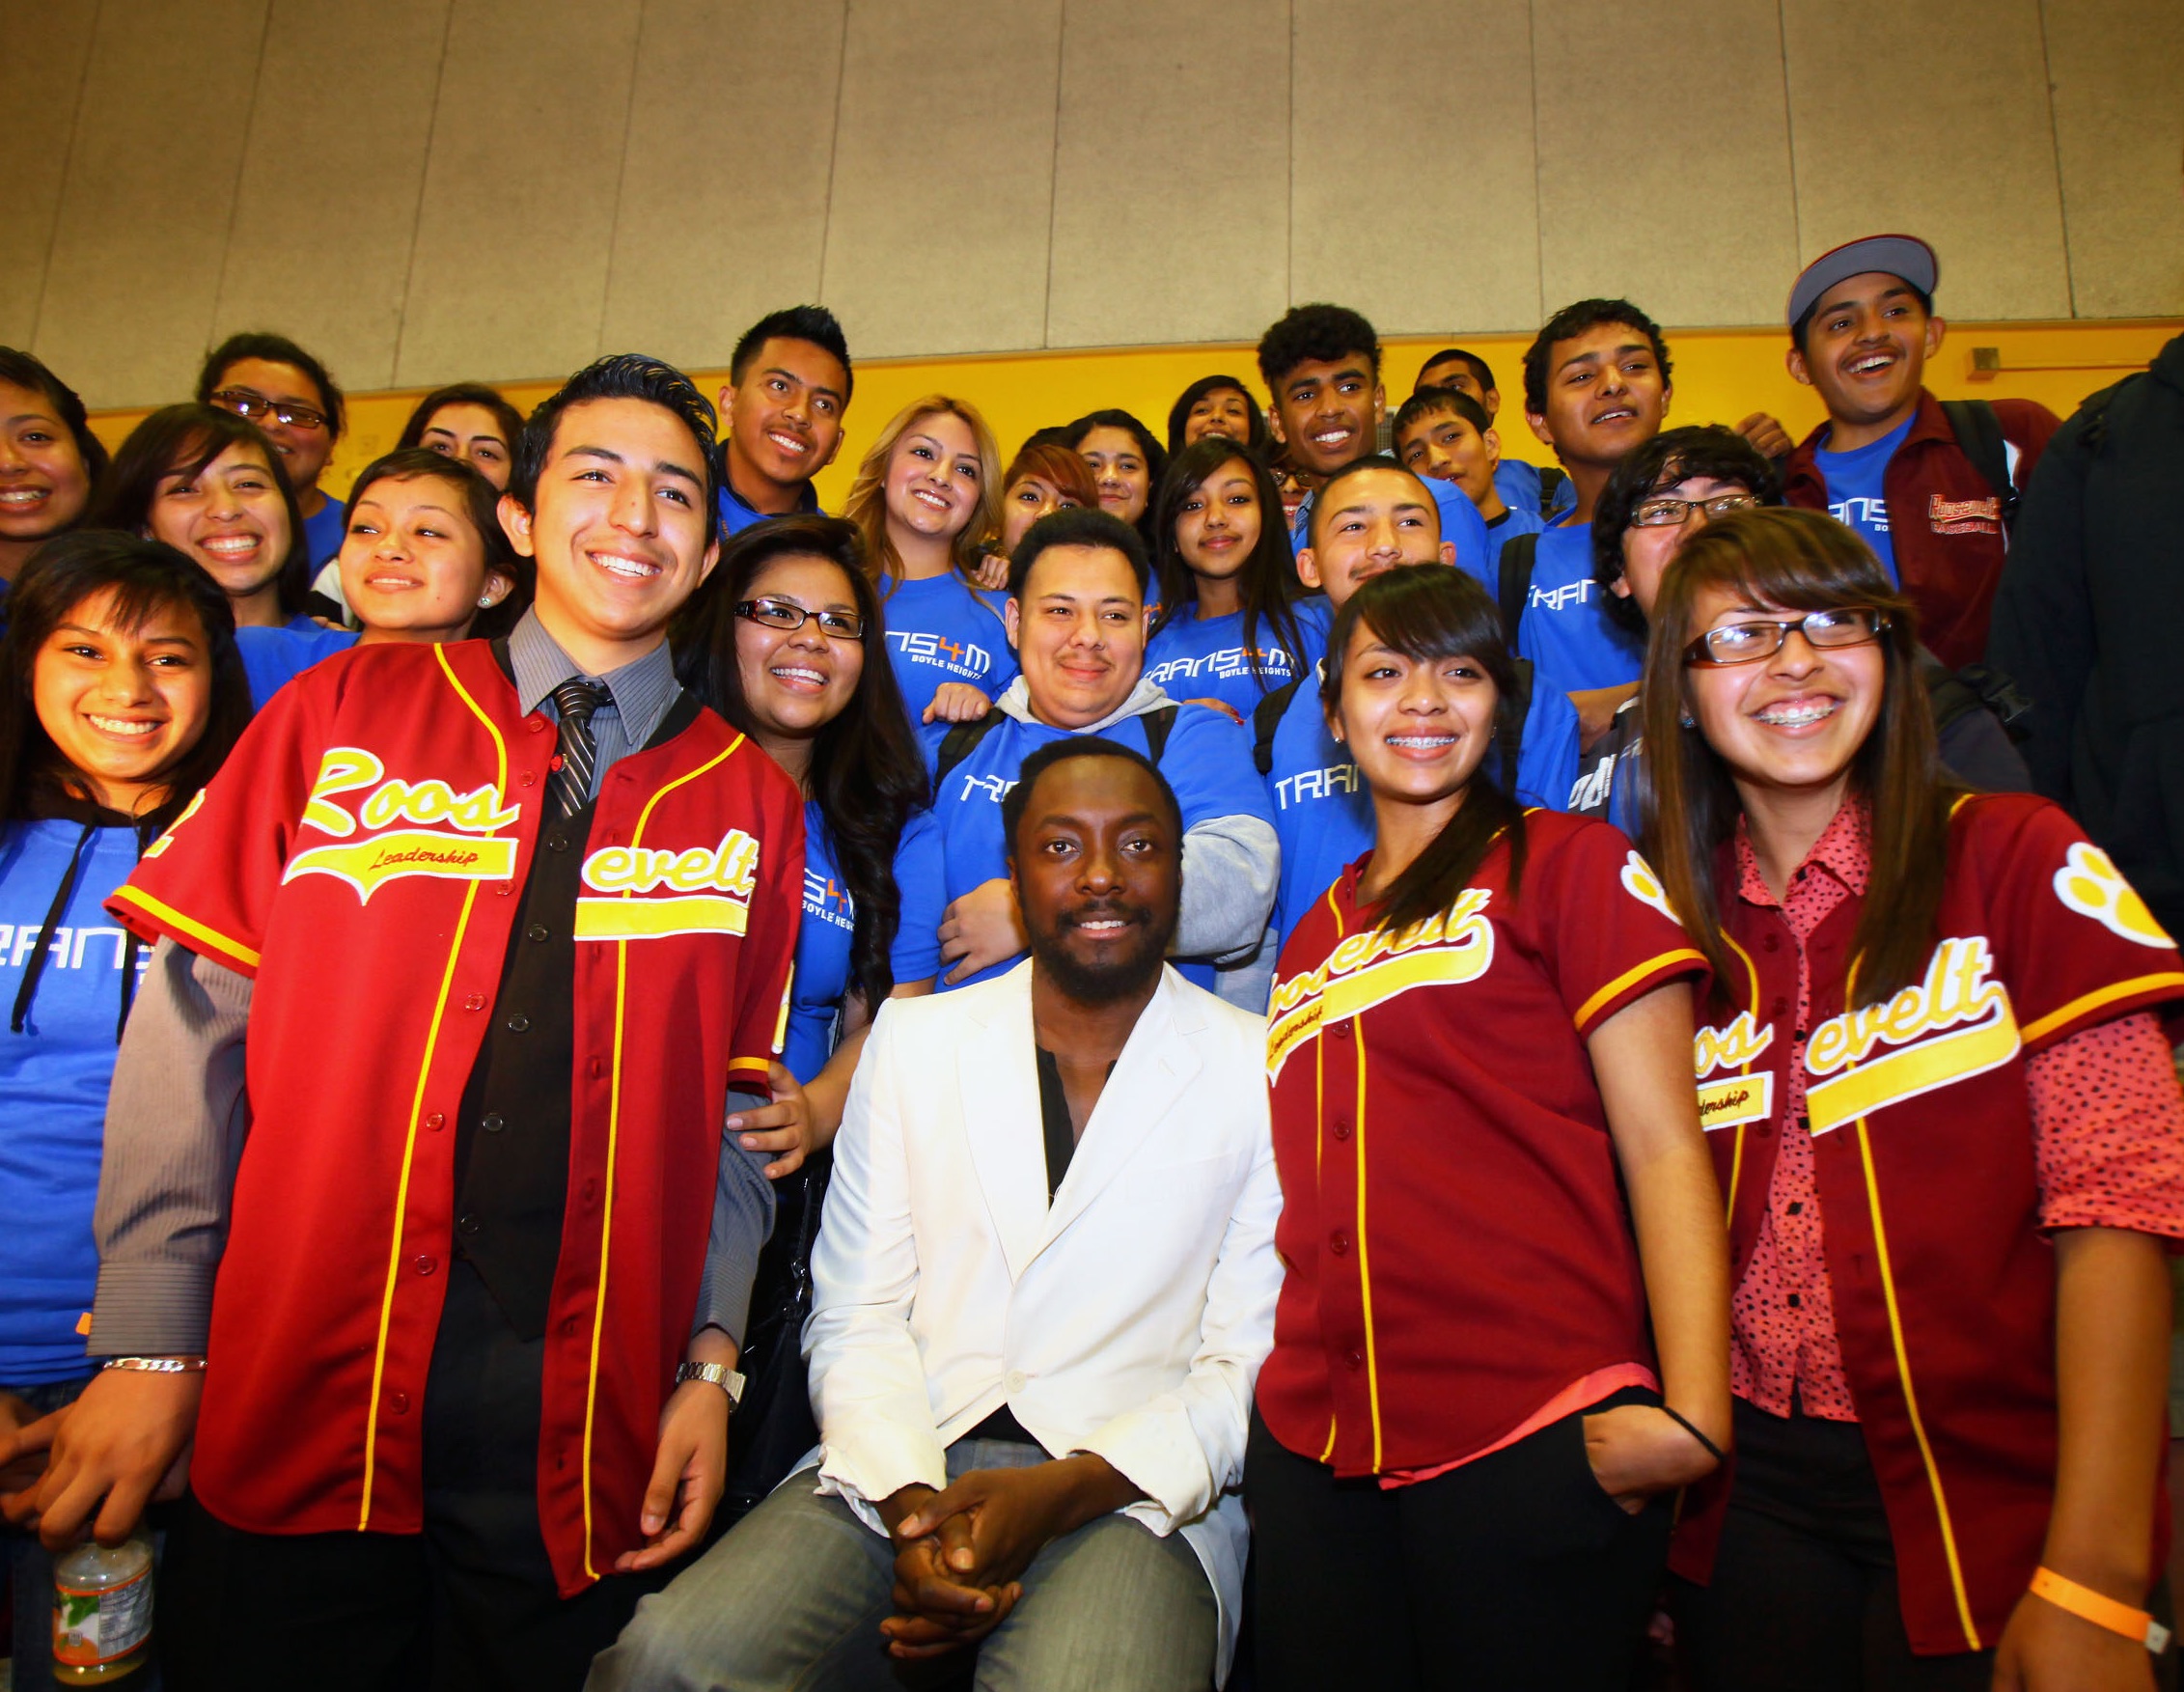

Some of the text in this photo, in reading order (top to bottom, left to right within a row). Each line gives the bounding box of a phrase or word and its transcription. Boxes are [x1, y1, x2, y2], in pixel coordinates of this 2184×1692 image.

[911, 654, 945, 668] BOYLE
[1219, 666, 1250, 679] BOYLE
[370, 846, 480, 873] Leadership
[581, 828, 760, 897] evelt
